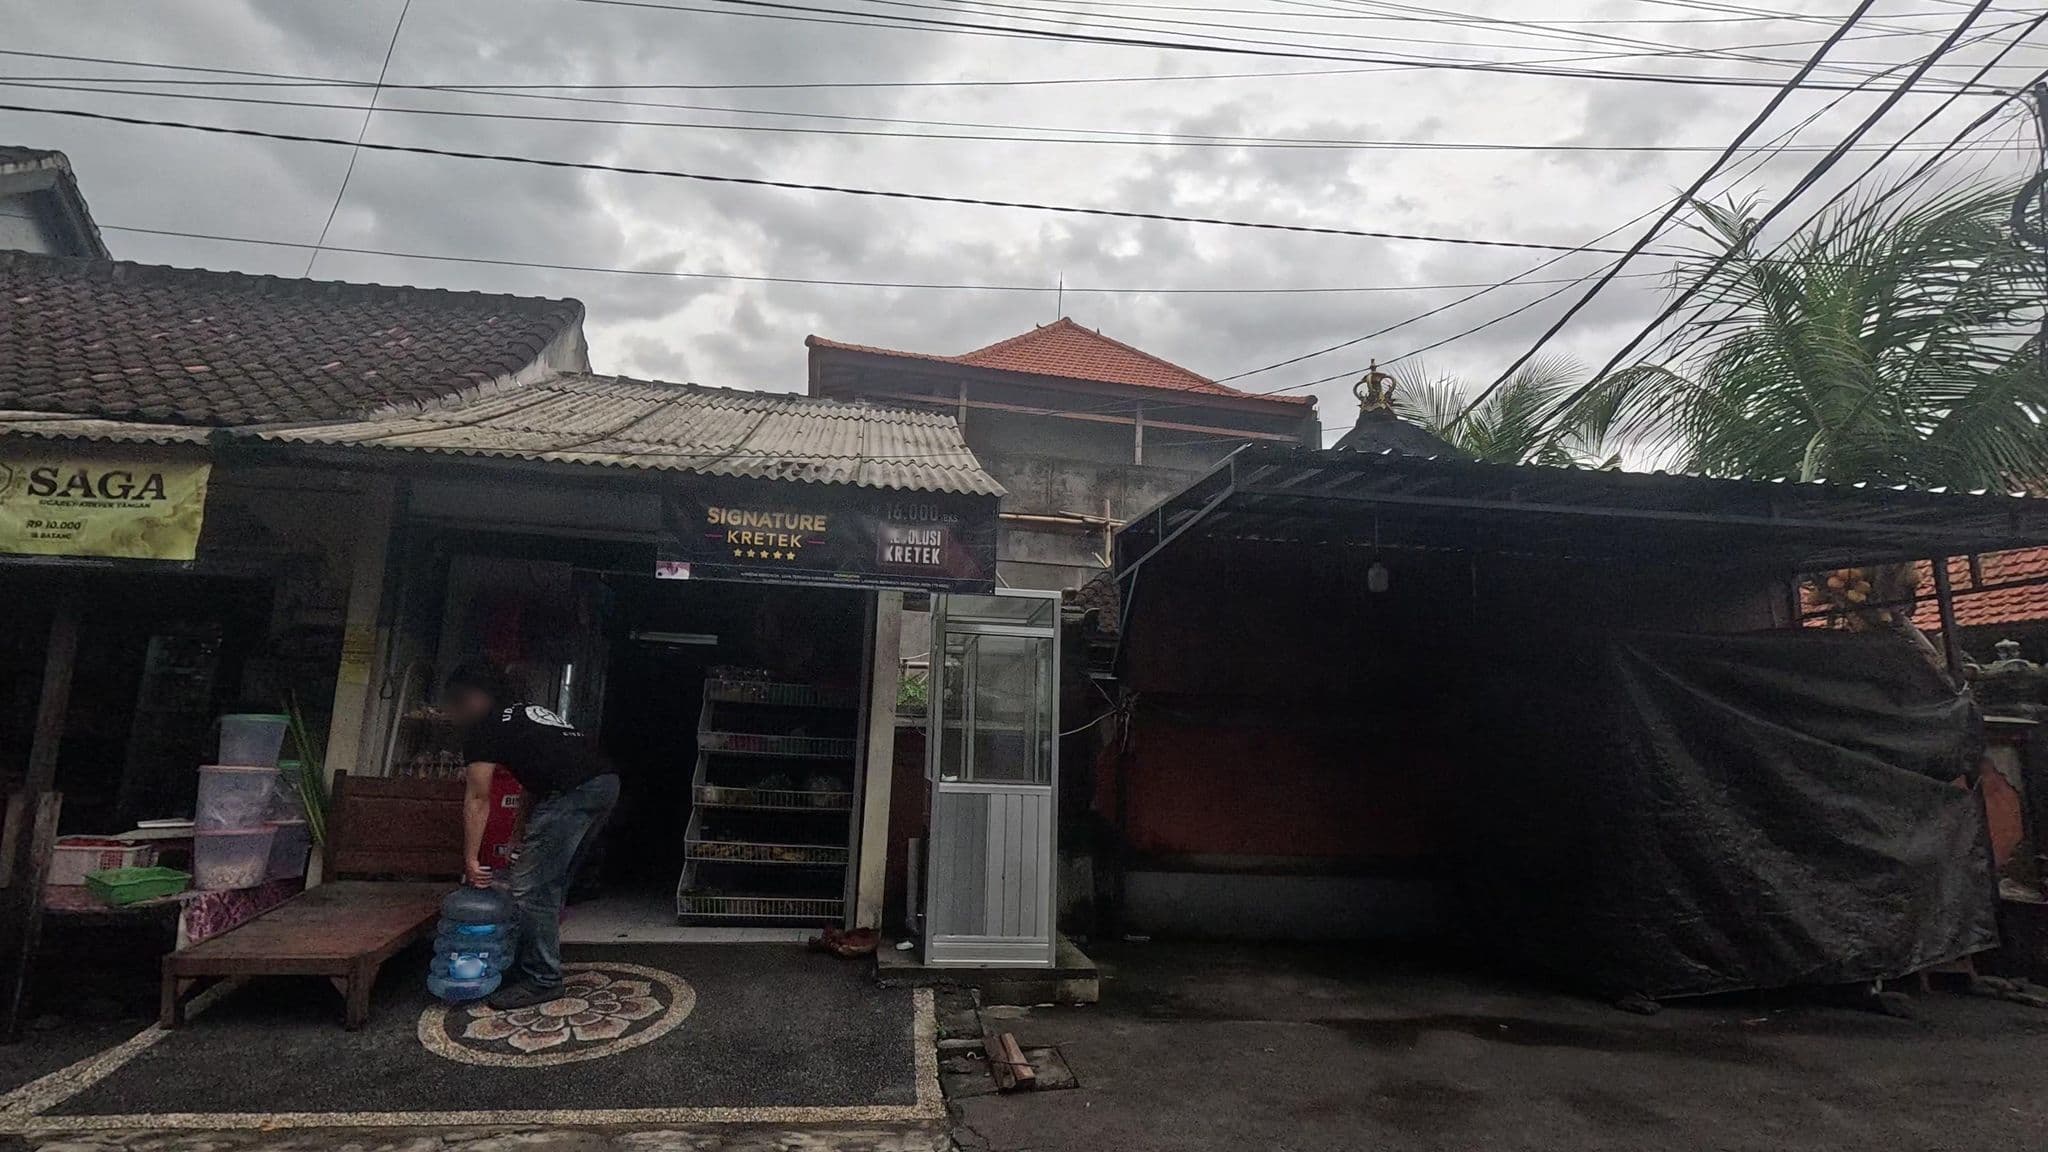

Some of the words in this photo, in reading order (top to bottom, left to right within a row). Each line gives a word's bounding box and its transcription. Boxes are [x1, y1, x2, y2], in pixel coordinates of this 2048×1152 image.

[27, 467, 167, 500] SAGA
[45, 520, 81, 530] 10.000
[707, 506, 828, 531] SIGNATURE
[727, 529, 802, 548] KRETEK
[886, 545, 940, 564] KRETEK
